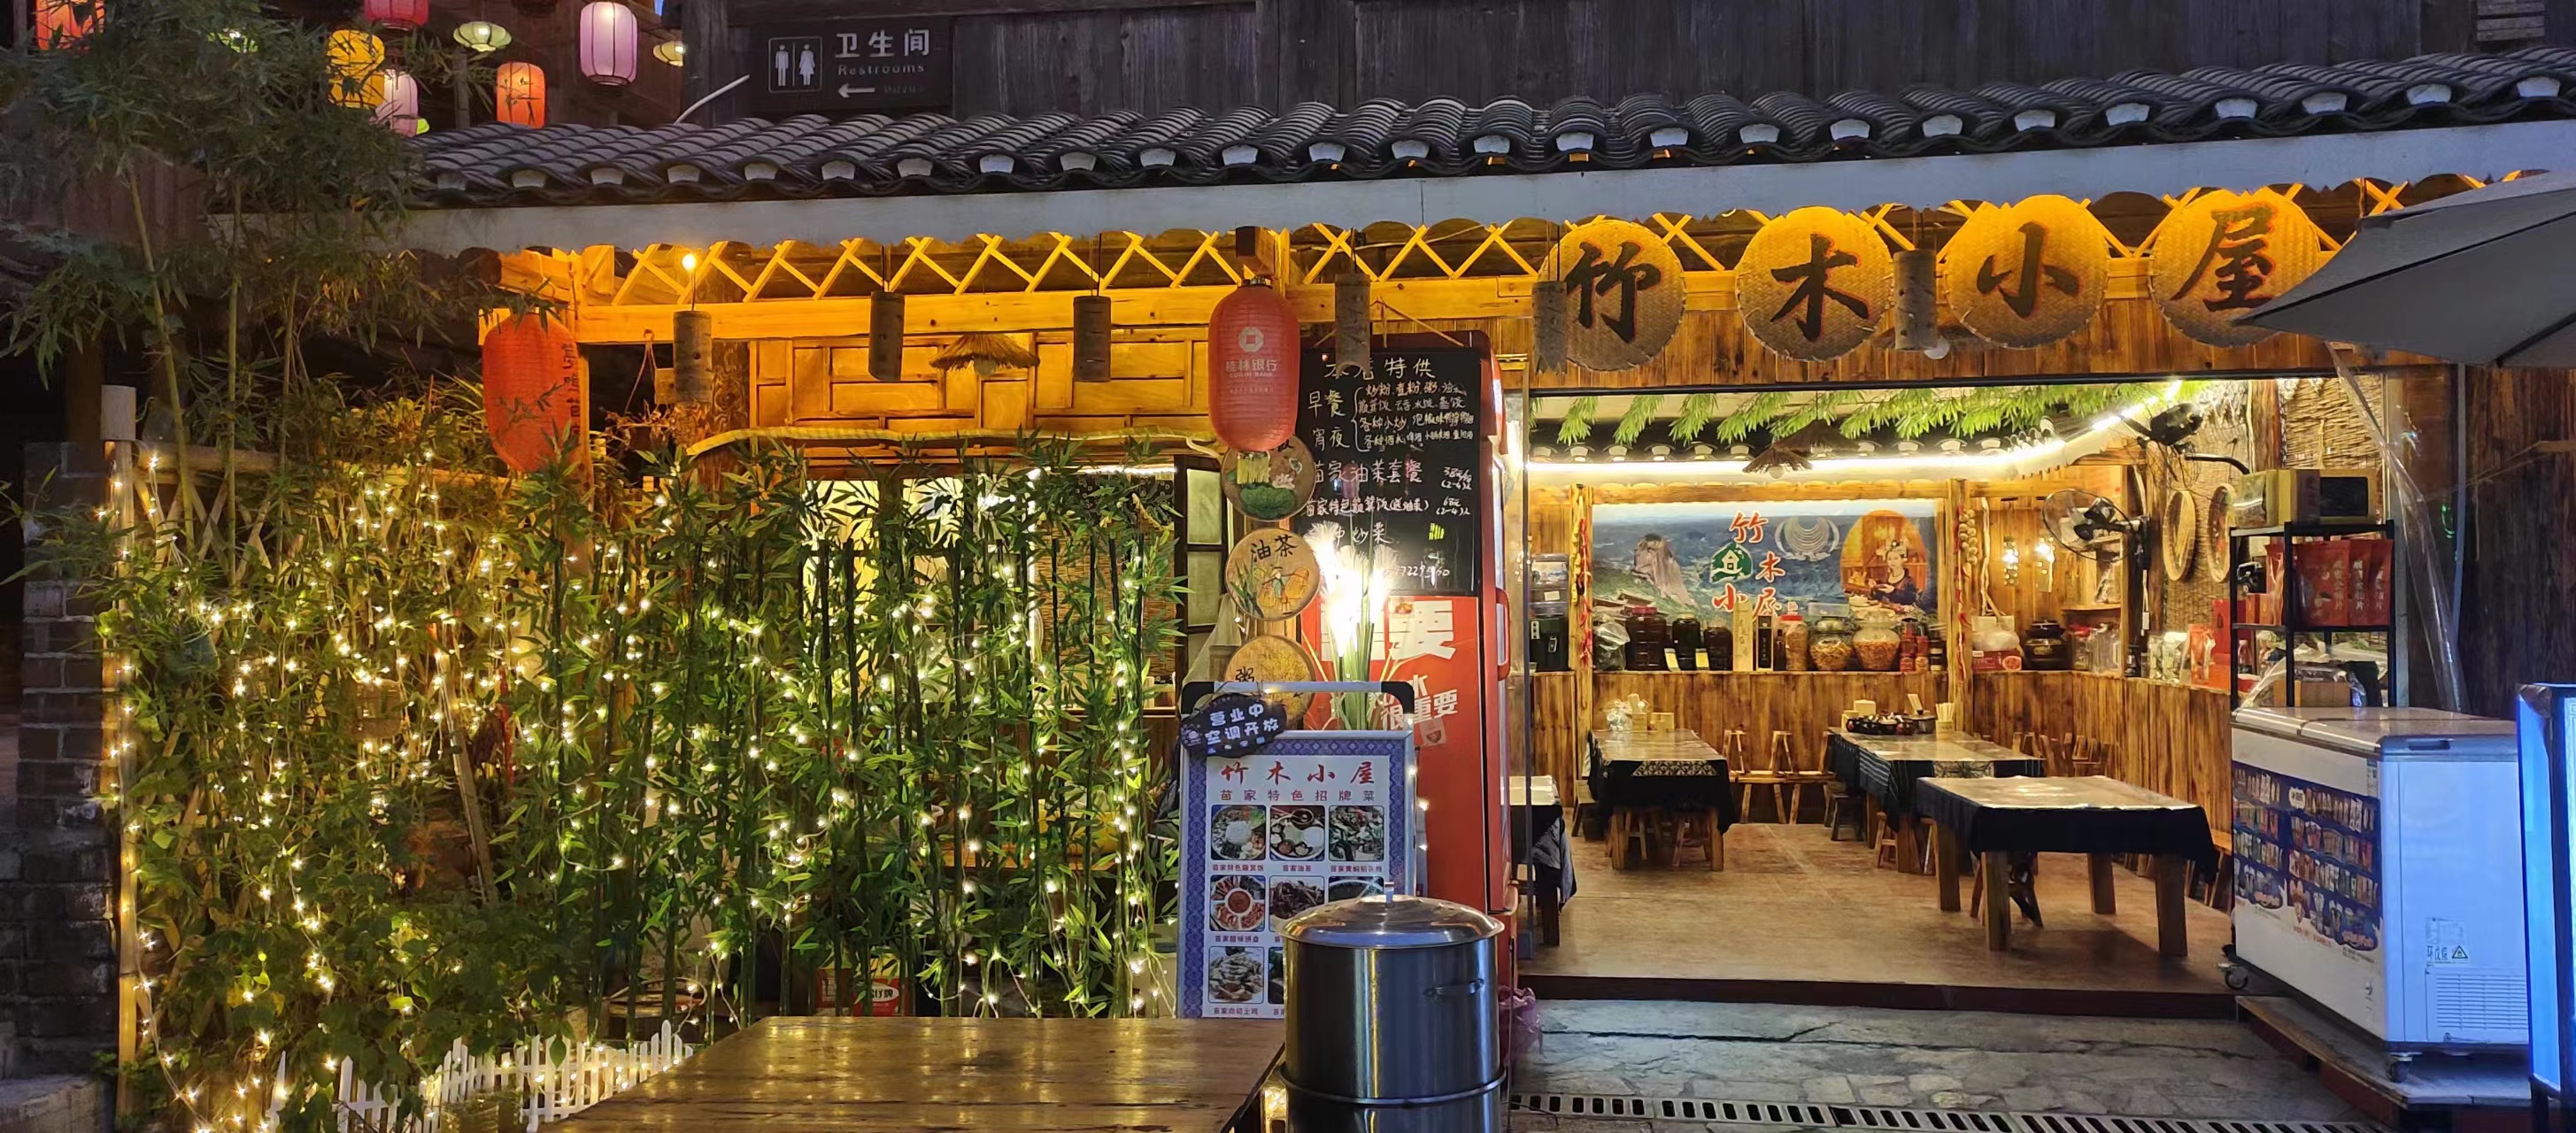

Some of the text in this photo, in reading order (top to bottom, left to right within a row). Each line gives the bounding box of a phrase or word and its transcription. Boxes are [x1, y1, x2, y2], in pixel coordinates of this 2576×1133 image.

[835, 28, 929, 58] 卫生间
[837, 64, 924, 75] Restrooms
[1565, 203, 2277, 343] 竹木小屋
[1225, 358, 1277, 372] 桂林银行
[1307, 389, 1346, 419] 早餐
[1313, 427, 1350, 451] 宵夜
[1250, 534, 1299, 562] 油茶
[1209, 703, 1264, 726] 营业中
[1205, 718, 1279, 745] 空调开放
[1221, 760, 1375, 786] 竹木小屋
[1220, 790, 1375, 802] 苗家特色招牌菜
